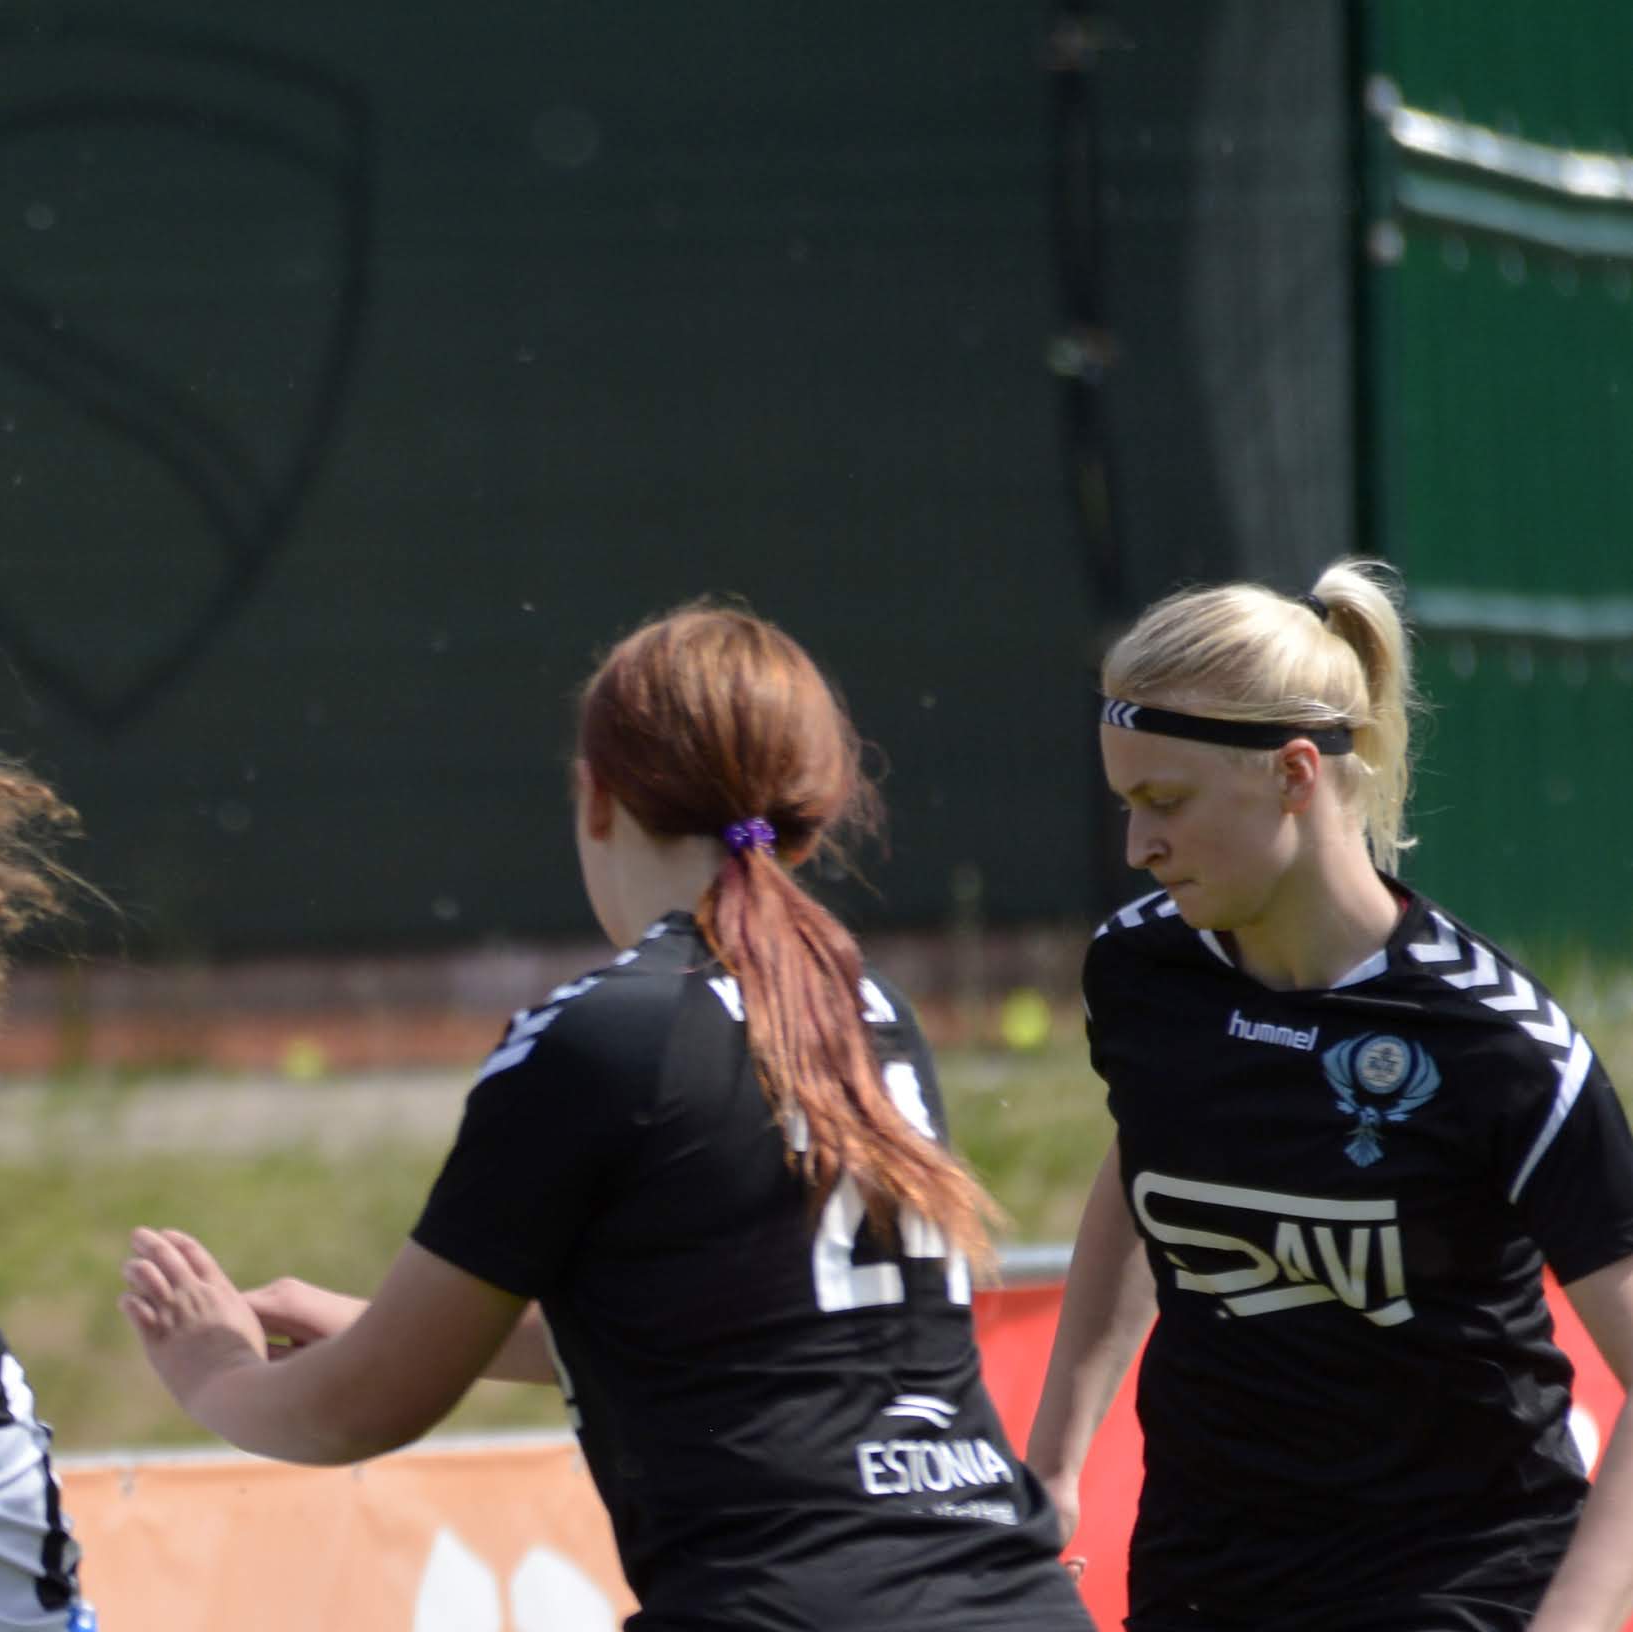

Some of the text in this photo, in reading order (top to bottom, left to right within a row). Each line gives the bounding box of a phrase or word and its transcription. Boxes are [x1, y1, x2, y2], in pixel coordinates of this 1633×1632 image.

[1228, 1009, 1319, 1051] hummel
[1132, 1170, 1416, 1328] SAVI
[857, 1437, 1015, 1495] ESTONIA
